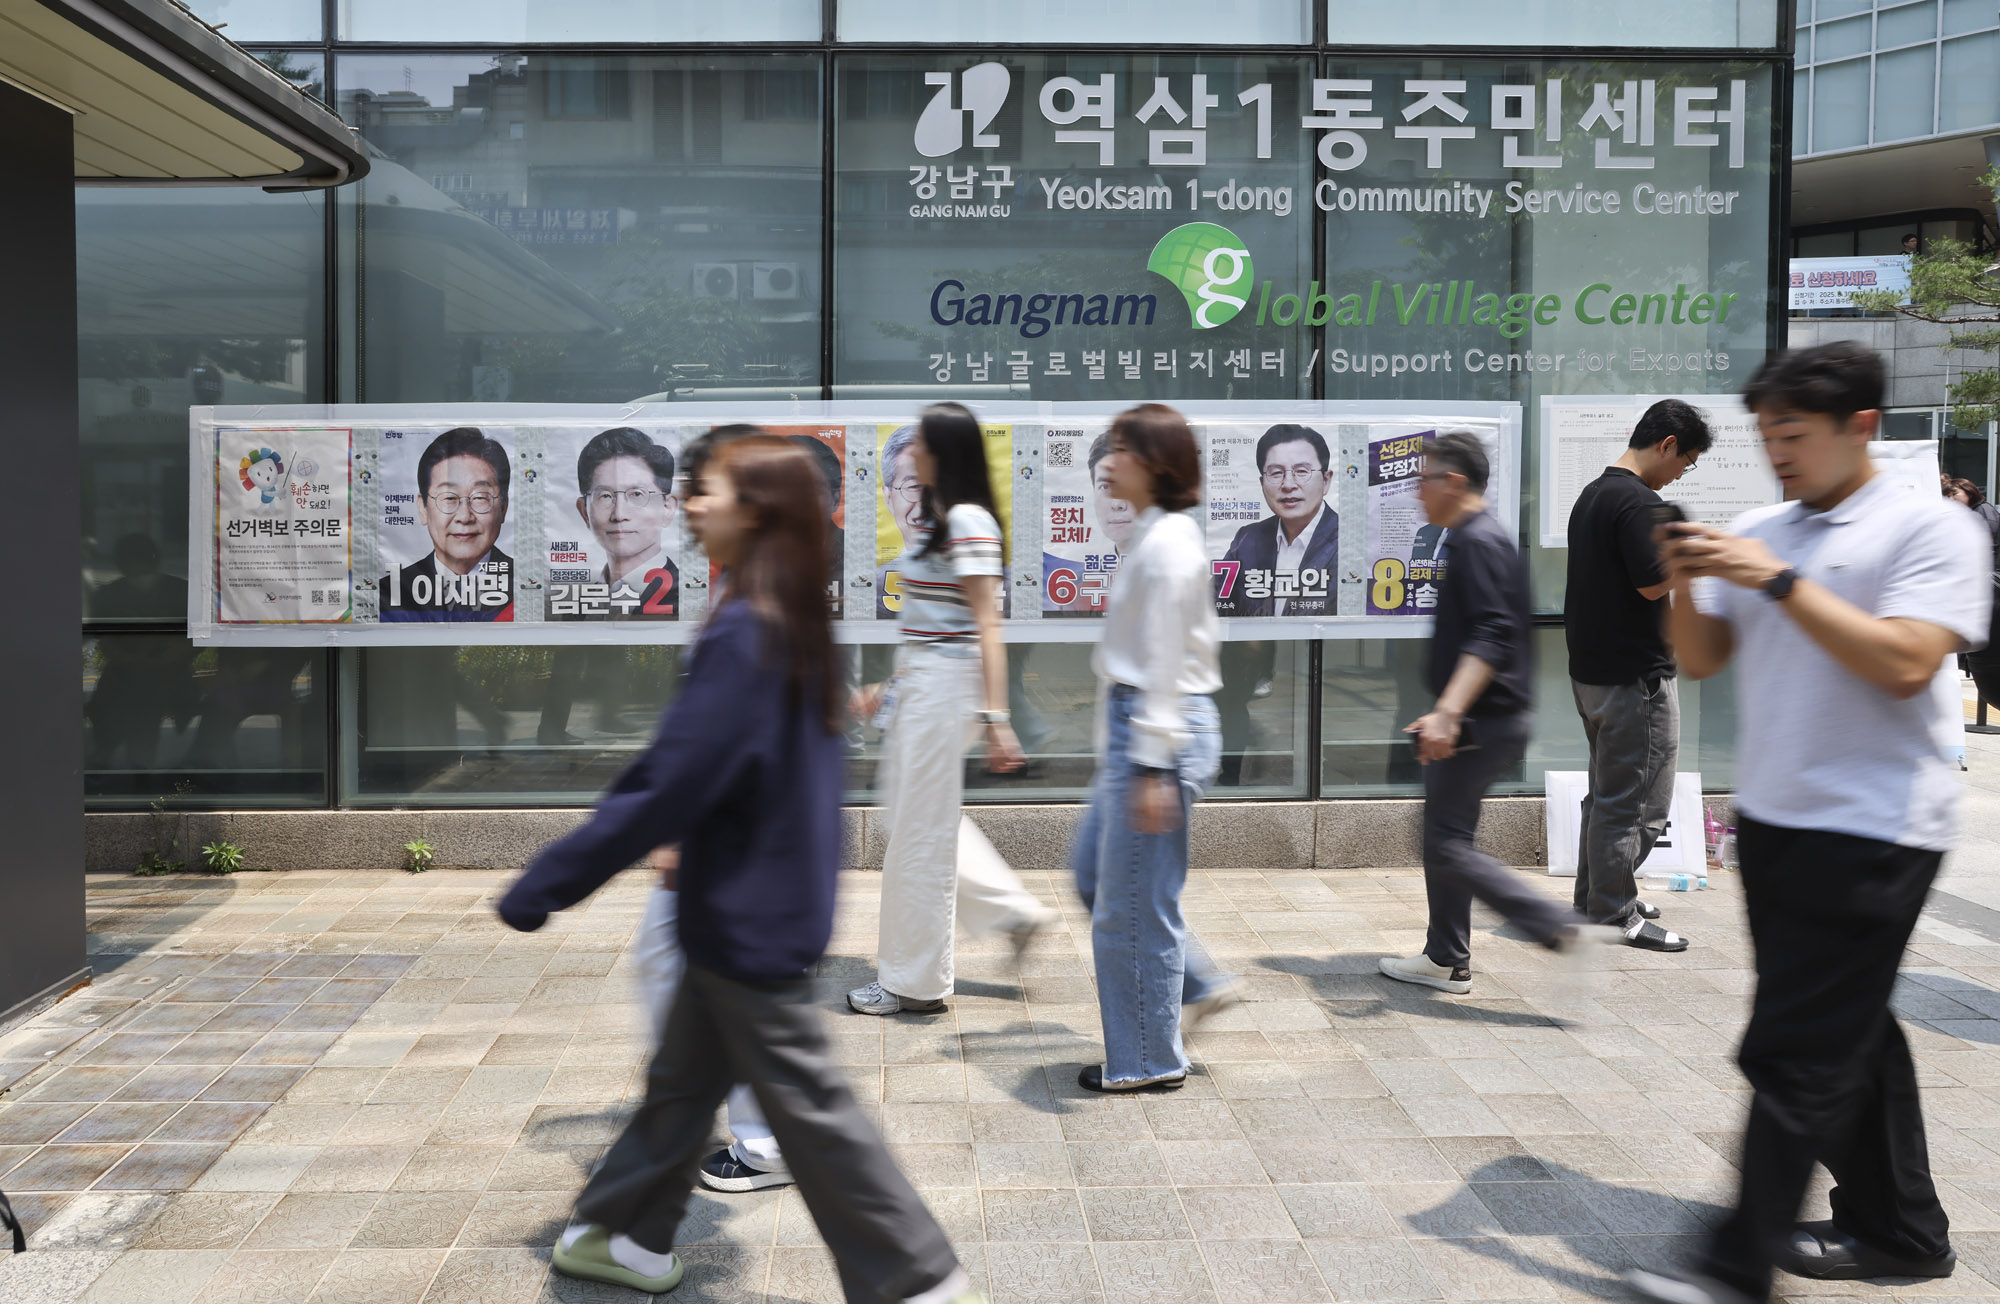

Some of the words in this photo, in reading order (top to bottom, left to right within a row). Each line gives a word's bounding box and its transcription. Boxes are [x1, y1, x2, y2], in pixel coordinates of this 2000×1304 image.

[1039, 73, 1747, 171] 역삼1동주민센터
[908, 165, 1015, 200] 강남구
[1040, 177, 1173, 212] Yeoksam
[1185, 178, 1293, 216] 1-dong
[1314, 179, 1492, 219] Community
[1505, 181, 1621, 214] Service
[1632, 183, 1740, 215] Center
[909, 204, 953, 218] GANG
[954, 204, 988, 218] NAM
[990, 204, 1011, 218] GU
[1808, 270, 1877, 288] 신청하세요
[929, 279, 1157, 340] Gangnam
[1391, 280, 1562, 339] Village
[1574, 283, 1740, 327] Center
[1330, 349, 1452, 378] Support
[1464, 349, 1566, 374] Center
[1576, 349, 1617, 373] for
[1628, 349, 1731, 378] Expats
[1378, 435, 1424, 461] 선경제
[290, 482, 330, 496] 훼손하면
[296, 497, 308, 510] 안
[309, 499, 331, 510] 돼요!
[384, 494, 415, 504] 이제부터
[1210, 502, 1239, 510] 부정선거
[1239, 502, 1261, 510] 척결로
[384, 505, 400, 515] 진짜
[1050, 507, 1084, 525] 정치
[1210, 512, 1239, 520] 청년에게
[1239, 512, 1260, 520] 미래를
[226, 519, 290, 538] 선거벽보
[293, 519, 342, 538] 주의문
[384, 516, 415, 526] 대한민국
[1050, 527, 1091, 543] 교체!
[550, 541, 579, 551] 새롭게
[550, 552, 588, 562] 대한민국
[1084, 554, 1118, 570] 젊은
[478, 561, 509, 573] 지금은
[551, 570, 588, 581] 정정당당
[385, 563, 402, 607] 1
[411, 574, 509, 607] 이재명
[1047, 568, 1078, 605] 6
[1211, 561, 1241, 599] 7
[1244, 568, 1330, 598] 황교안
[1372, 557, 1406, 610] 8
[550, 583, 641, 615] 김문수
[642, 567, 674, 615] 2
[1406, 583, 1415, 608] 무소속
[1289, 601, 1297, 610] 전
[1298, 601, 1325, 609] 국무총리
